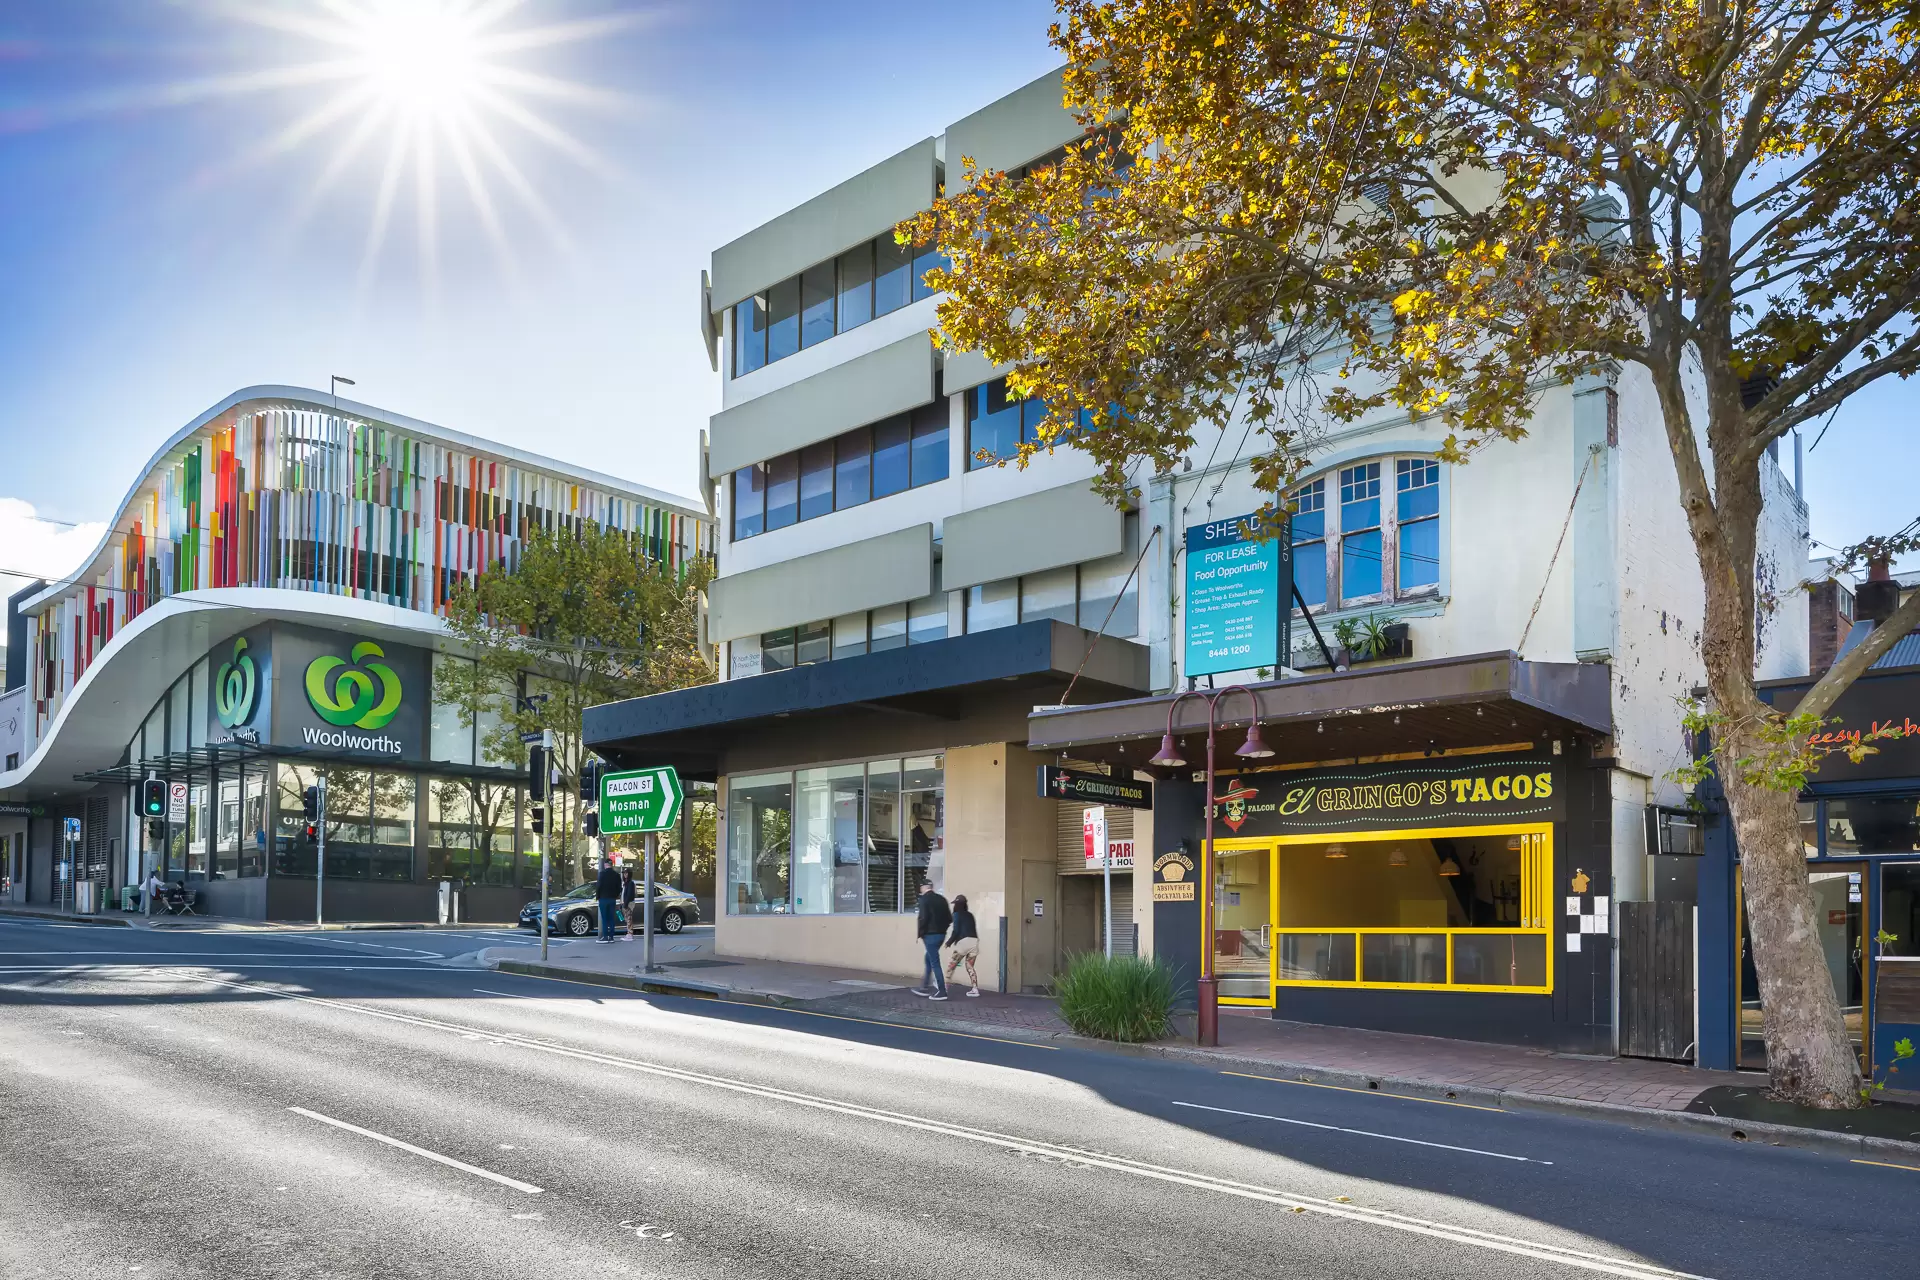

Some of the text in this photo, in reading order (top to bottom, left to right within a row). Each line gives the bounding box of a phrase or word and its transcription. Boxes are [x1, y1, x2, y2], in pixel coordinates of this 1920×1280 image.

[1205, 516, 1260, 540] SHEAD
[1205, 545, 1257, 563] FOR LEASE
[1195, 560, 1268, 580] Food Opportunity
[1215, 583, 1243, 591] Woolworths
[1209, 644, 1250, 657] 8448 1200
[216, 728, 256, 744] Woolorths
[302, 728, 402, 753] Woolworths
[608, 780, 651, 792] FALCON ST
[1076, 780, 1142, 799] El GRINGO'S TACOS
[1279, 772, 1552, 816] El GRINGO'S TACOS
[610, 800, 650, 812] Mosman
[1248, 804, 1276, 812] FALCON
[614, 815, 644, 828] Manly
[1109, 843, 1133, 858] PAR
[1154, 852, 1194, 870] WORMWOODS
